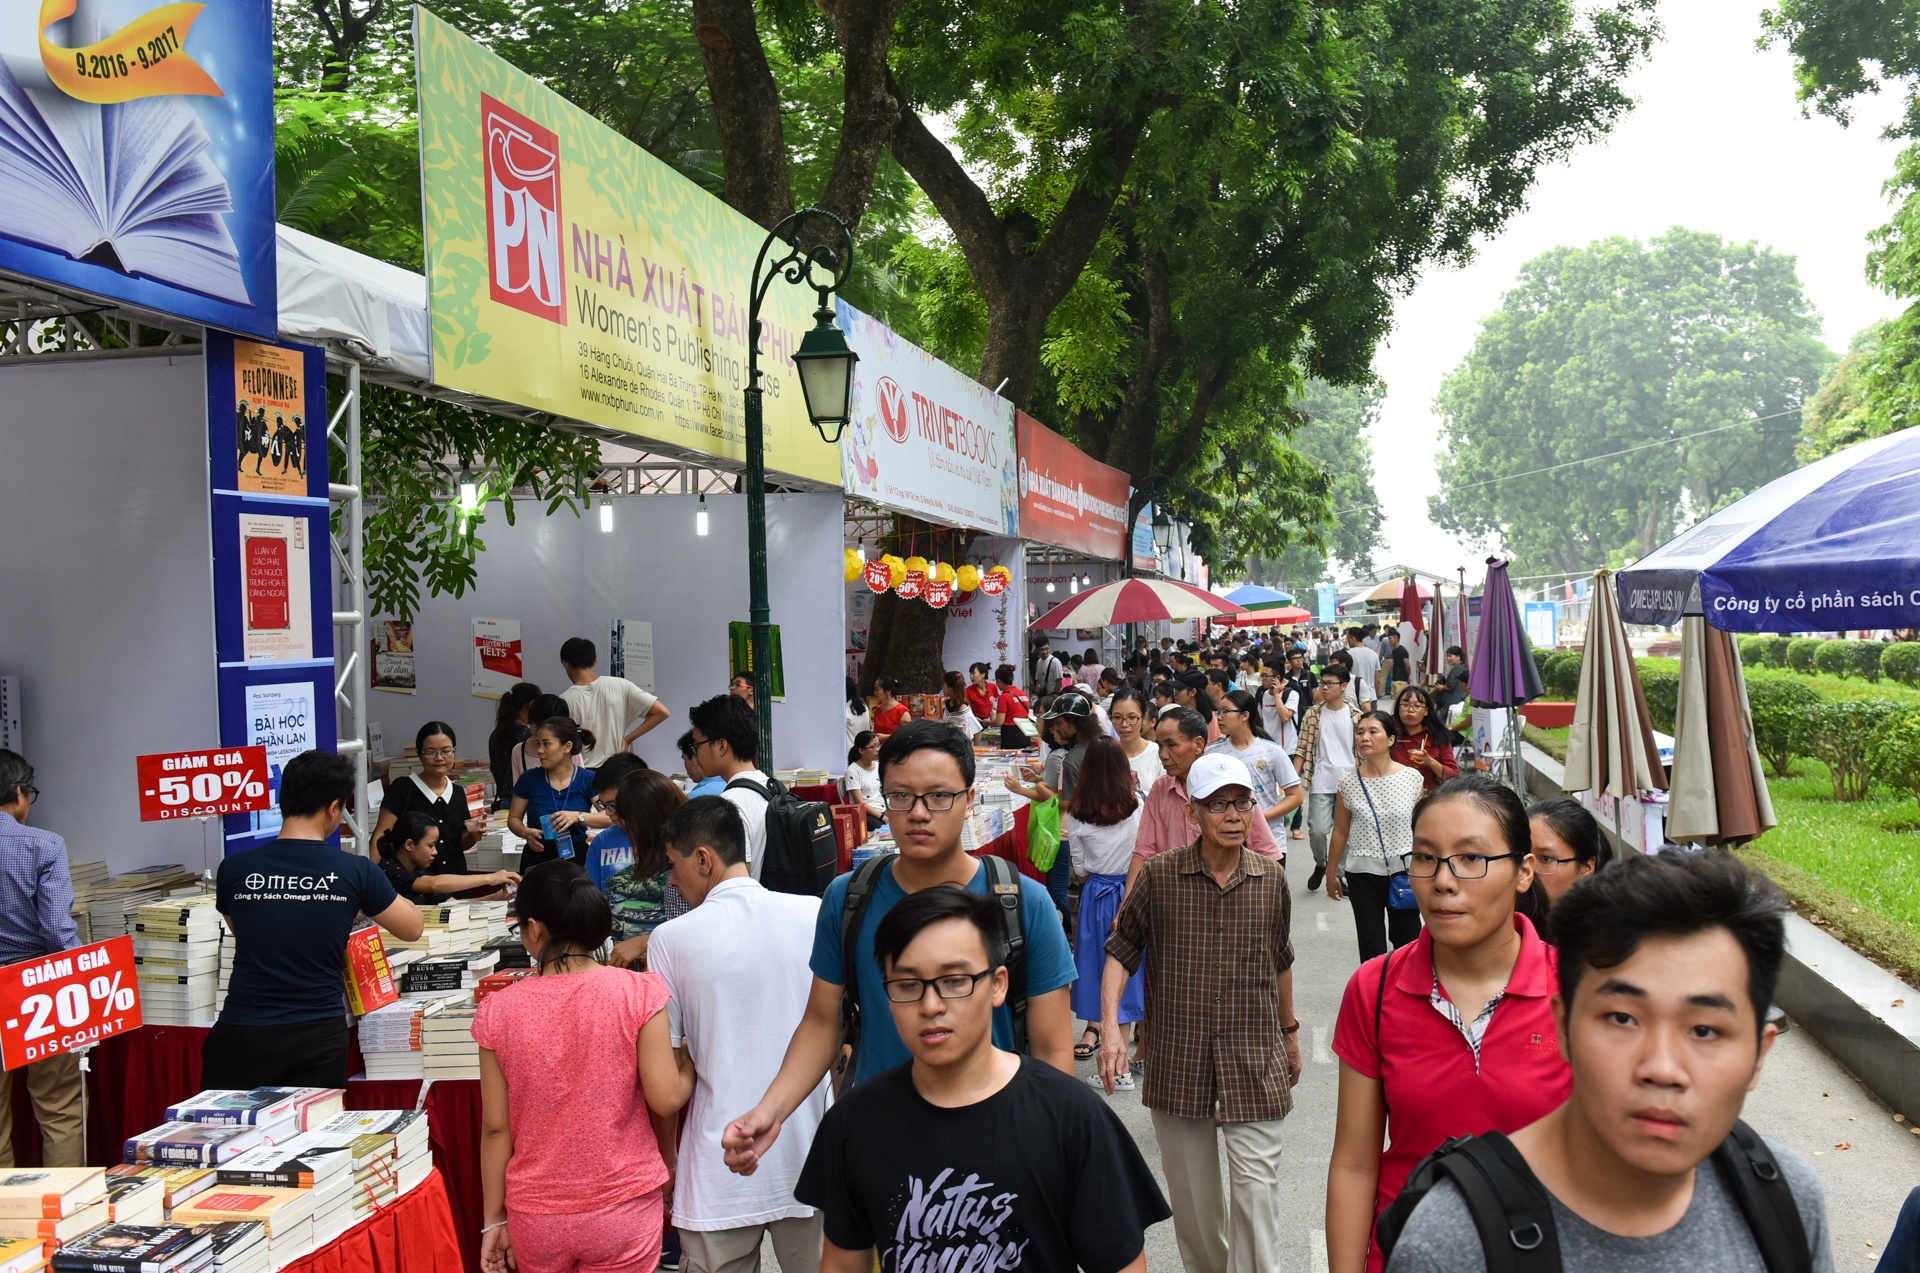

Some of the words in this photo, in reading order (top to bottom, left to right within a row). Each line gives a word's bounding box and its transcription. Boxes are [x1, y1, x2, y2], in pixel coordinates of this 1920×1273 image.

[76, 52, 128, 79] 9.2016
[137, 26, 179, 69] 9.2017
[572, 222, 636, 298] NHÀ
[641, 256, 705, 328] XUẤT
[575, 285, 661, 353] Women's
[667, 323, 740, 391] Publishing
[744, 357, 780, 398] huse
[578, 341, 588, 357] 39
[590, 345, 610, 368] Hàng
[637, 361, 656, 381] Quận
[657, 368, 668, 385] Hai
[669, 373, 678, 388] Bà
[699, 384, 708, 398] TP
[709, 388, 716, 401] Hà
[243, 367, 297, 400] PELOPONNESE
[580, 364, 589, 379] 16
[591, 367, 628, 391] Alexandre
[629, 380, 638, 394] de
[669, 392, 685, 409] Quận
[693, 400, 702, 413] TP
[703, 402, 710, 417] Hồ
[580, 387, 664, 421] www.nxbphunu.com.vn
[912, 390, 998, 469] TRIVIETBOOKS
[869, 571, 887, 587] 20%
[898, 582, 919, 594] 50%
[983, 582, 1004, 592] 50%
[1026, 575, 1049, 585] RỌNG
[929, 592, 948, 603] 30%
[1630, 589, 1684, 611] OMEGAPLUS.VN
[1714, 596, 1760, 614] Công
[1764, 595, 1780, 614] ty
[1785, 591, 1806, 610] cổ
[1811, 590, 1855, 612] phần
[1860, 591, 1904, 608] sách
[949, 608, 973, 619] Việt
[483, 647, 507, 657] IELTS
[255, 713, 274, 731] BÀI
[279, 714, 305, 731] HỌC
[256, 731, 283, 747] PHẦN
[287, 732, 306, 745] LAN
[162, 754, 208, 770] GIẢM
[213, 751, 244, 767] GIÁ
[145, 769, 264, 806] -50%
[160, 802, 252, 819] DISCOUNT
[283, 893, 311, 902] Omega
[313, 893, 328, 901] Việt
[368, 939, 380, 953] 30
[22, 957, 73, 987] GIẢM
[77, 946, 110, 973] GIÁ
[6, 970, 135, 1042] -20%
[26, 1018, 124, 1060] DISCOUNT
[162, 1145, 168, 1158] LÝ
[168, 1148, 185, 1159] QUANG
[186, 1146, 198, 1159] DIỆU
[895, 1167, 1018, 1244] Natus
[120, 1245, 155, 1259] ELON
[145, 1228, 183, 1245] MUSK
[93, 1263, 108, 1272] ELON
[109, 1265, 125, 1273] MUSK
